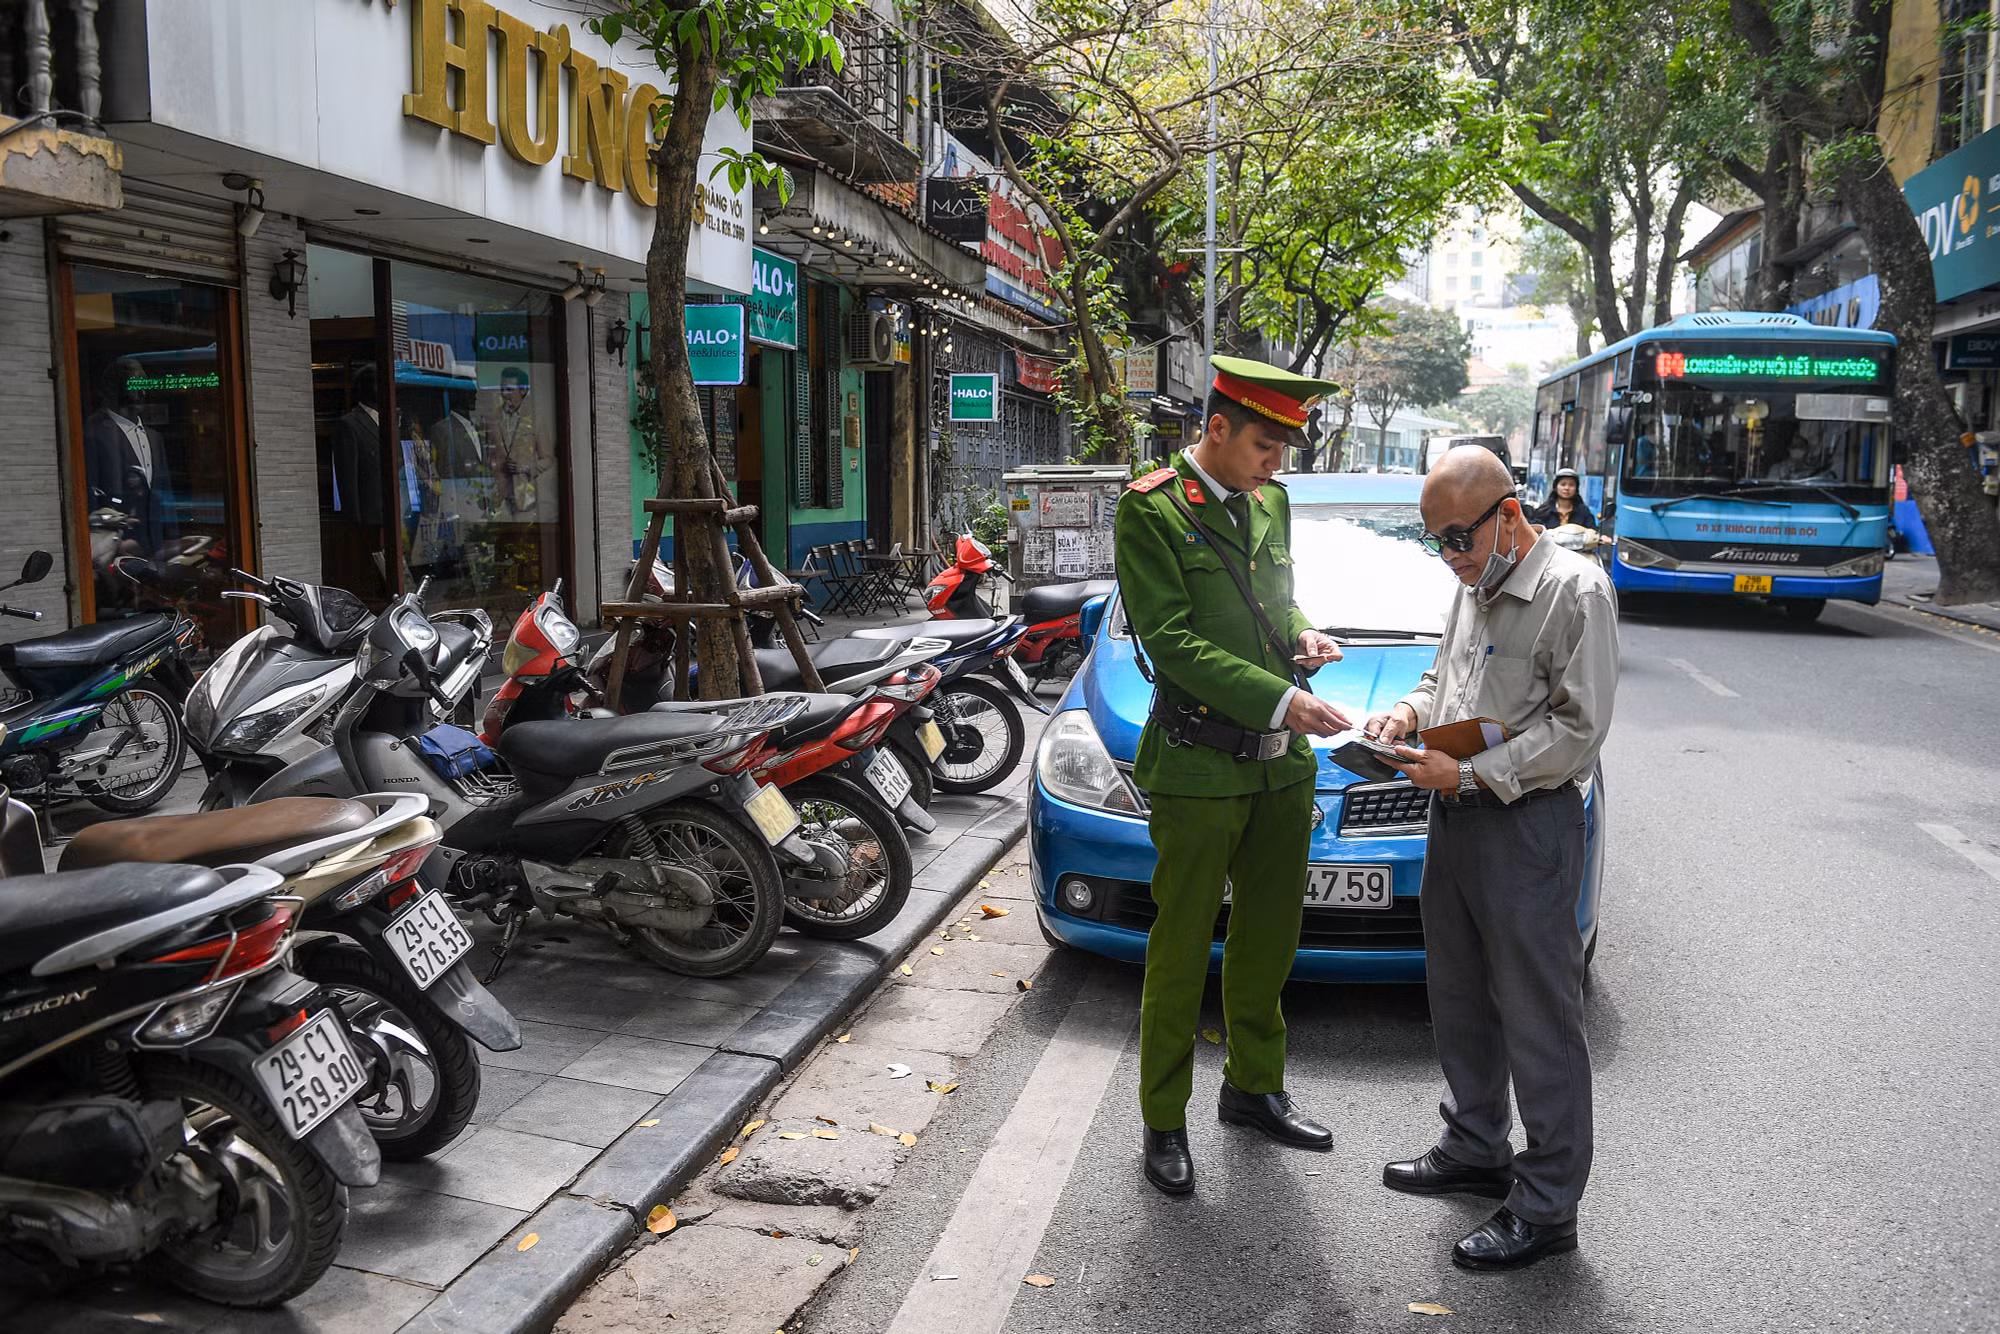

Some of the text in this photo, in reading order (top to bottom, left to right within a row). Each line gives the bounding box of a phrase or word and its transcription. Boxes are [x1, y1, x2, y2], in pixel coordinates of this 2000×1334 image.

[704, 186, 728, 213] HÀNG
[752, 260, 783, 297] ALO
[957, 388, 987, 399] HALO
[383, 776, 421, 785] HONDA
[395, 900, 446, 953] 29-C1
[409, 921, 467, 982] 676.55
[270, 1023, 336, 1091] 29-C1
[283, 1053, 358, 1131] 259.90
